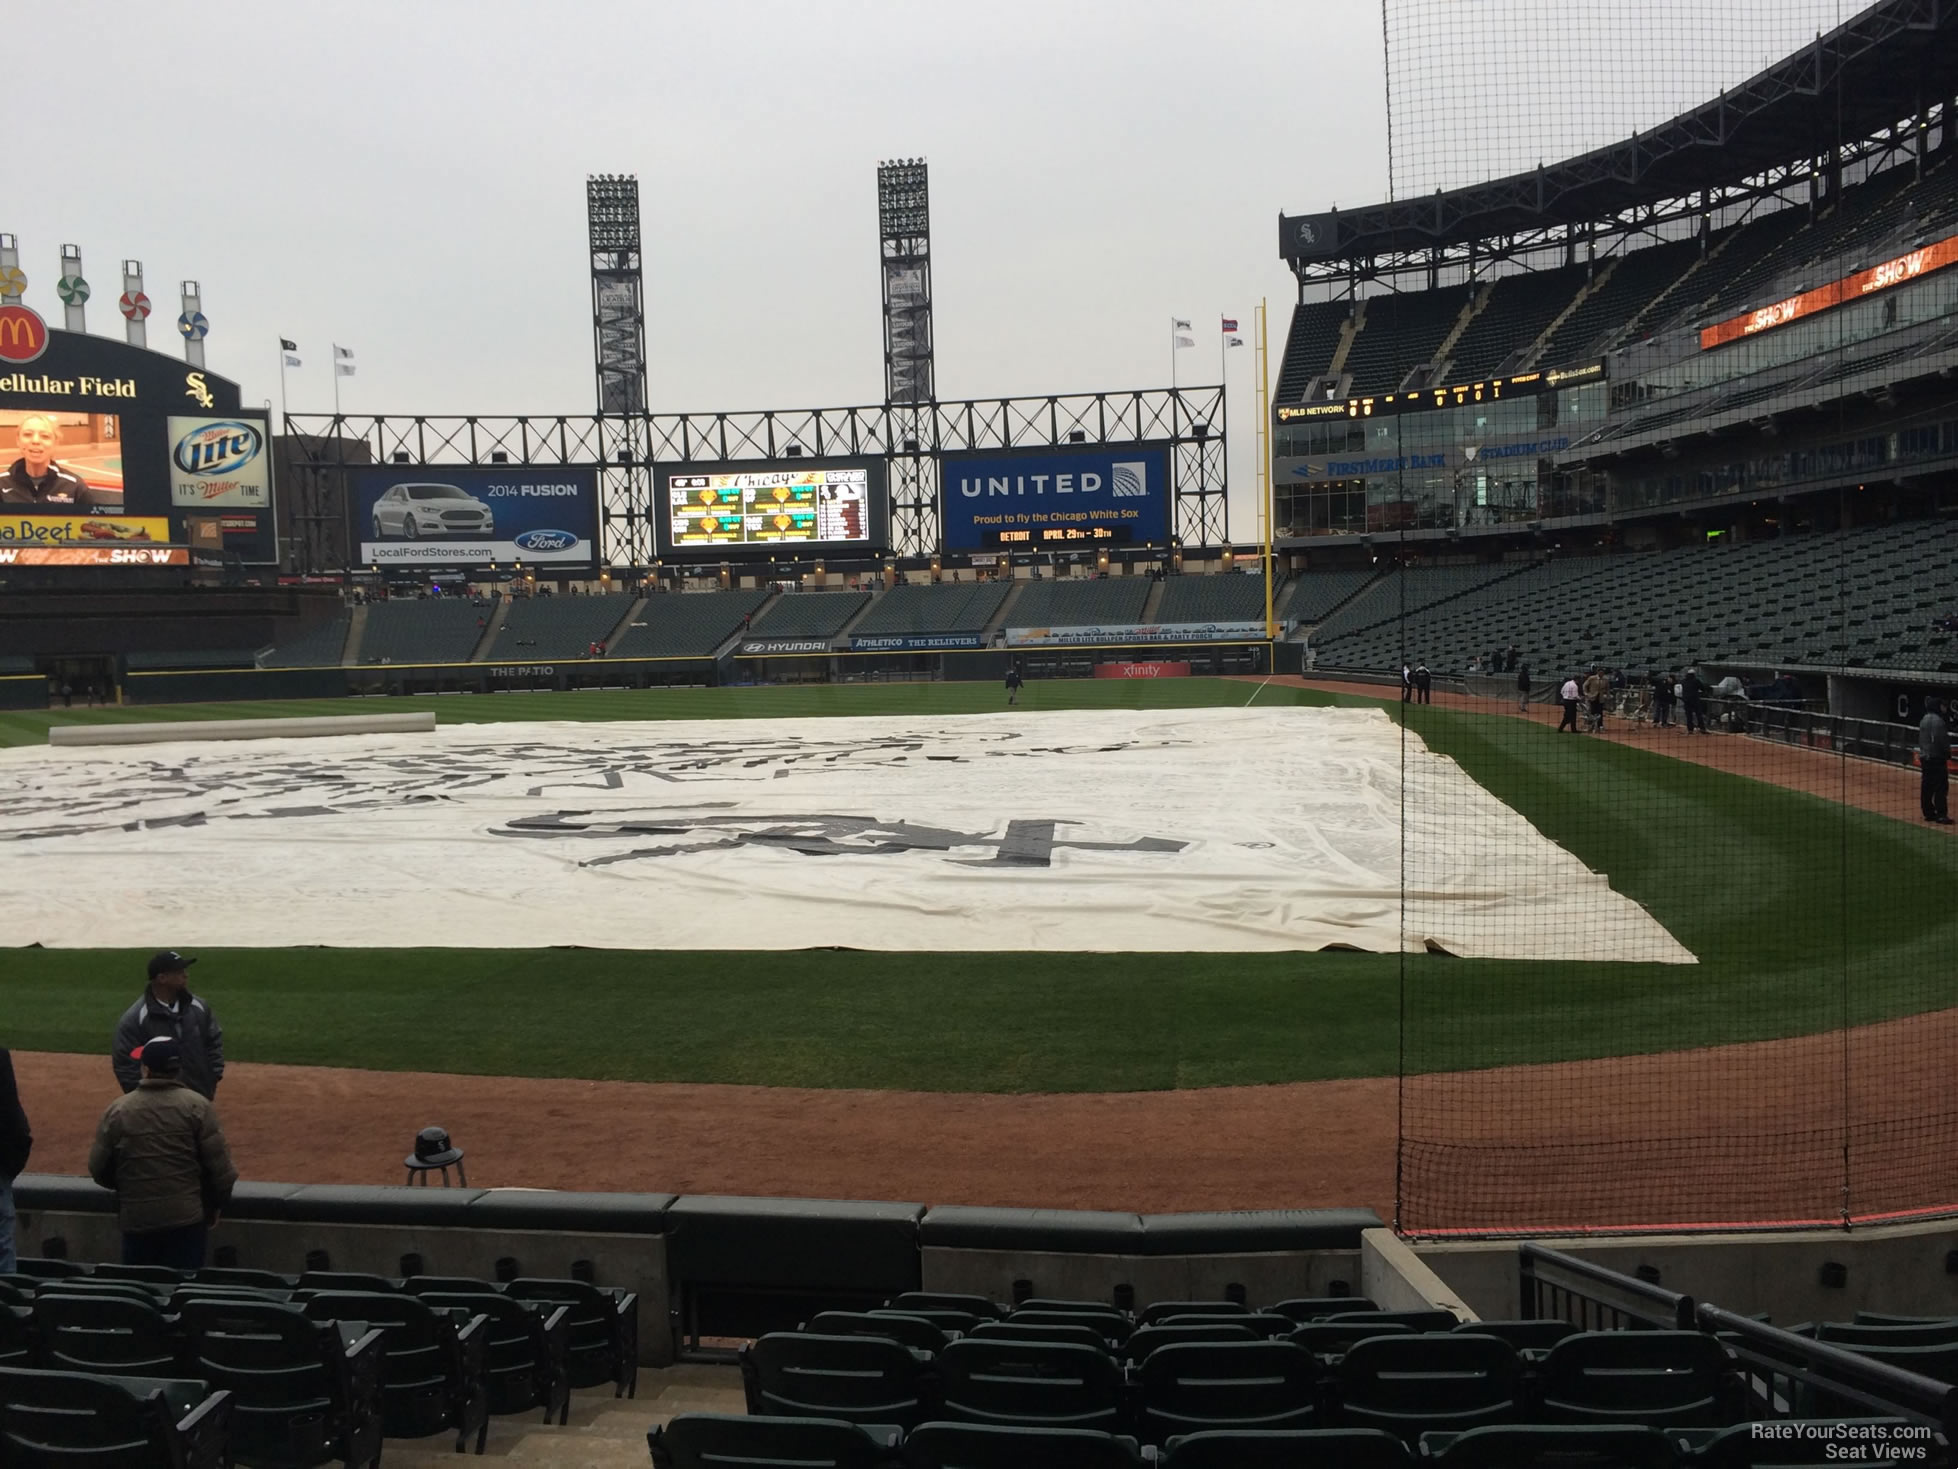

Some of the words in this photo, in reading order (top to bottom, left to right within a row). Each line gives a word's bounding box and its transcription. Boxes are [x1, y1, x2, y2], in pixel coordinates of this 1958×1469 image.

[1873, 250, 1926, 288] SHOW
[1755, 298, 1797, 329] SHOW
[78, 376, 137, 398] Field
[1290, 409, 1306, 417] MLB
[1306, 405, 1345, 415] NETWORK
[188, 432, 250, 474] Lite
[1410, 453, 1446, 469] BANK
[179, 484, 195, 496] IT'S
[196, 481, 240, 499] Miller
[240, 485, 260, 497] TIME
[488, 485, 519, 497] 2014
[521, 484, 578, 497] FUSION
[961, 472, 1102, 498] UNITED
[974, 515, 1002, 525] Proud
[1005, 514, 1015, 523] to
[1017, 513, 1030, 524] fly
[1032, 513, 1049, 522] the
[1050, 511, 1088, 523] Chicago
[1089, 509, 1119, 519] White
[1121, 509, 1139, 518] Sox
[20, 520, 73, 540] Beef
[1000, 530, 1031, 542] DETROIT
[1043, 529, 1065, 540] APRIL
[527, 533, 566, 550] Ford
[110, 549, 173, 564] SHOW
[372, 546, 493, 558] LocalFordStores.com
[767, 642, 826, 651] HYUNDAI
[856, 637, 903, 648] ATHLETICO
[908, 639, 927, 647] THE
[928, 637, 977, 647] RELIEVERS
[490, 667, 515, 677] THE
[518, 666, 554, 676] PATIO
[1123, 664, 1161, 678] xfinity
